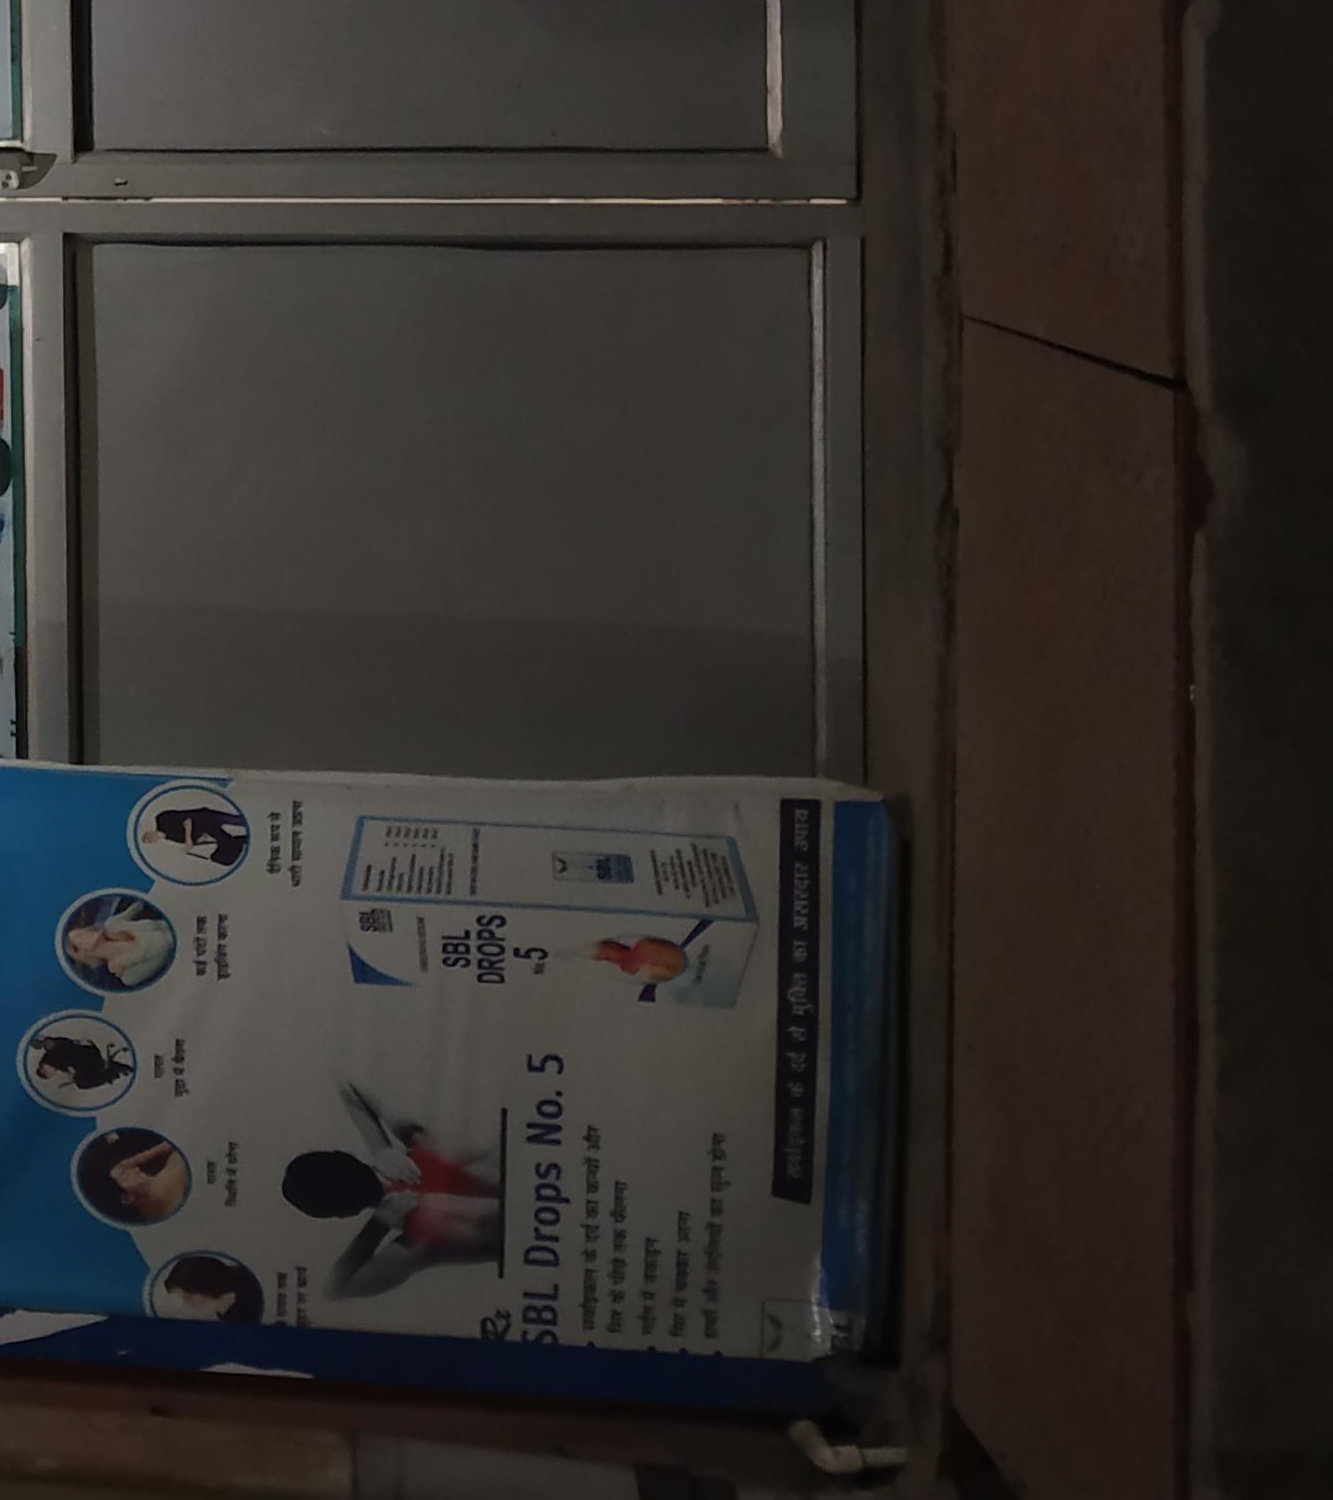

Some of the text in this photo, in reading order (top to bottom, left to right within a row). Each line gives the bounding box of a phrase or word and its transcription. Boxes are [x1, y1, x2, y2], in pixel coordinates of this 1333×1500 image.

[359, 908, 379, 933] SBL
[441, 929, 472, 969] SBL
[476, 914, 507, 985] DROPS
[513, 946, 549, 961] 5
[521, 1053, 571, 1345] SBL Drops No. 5
